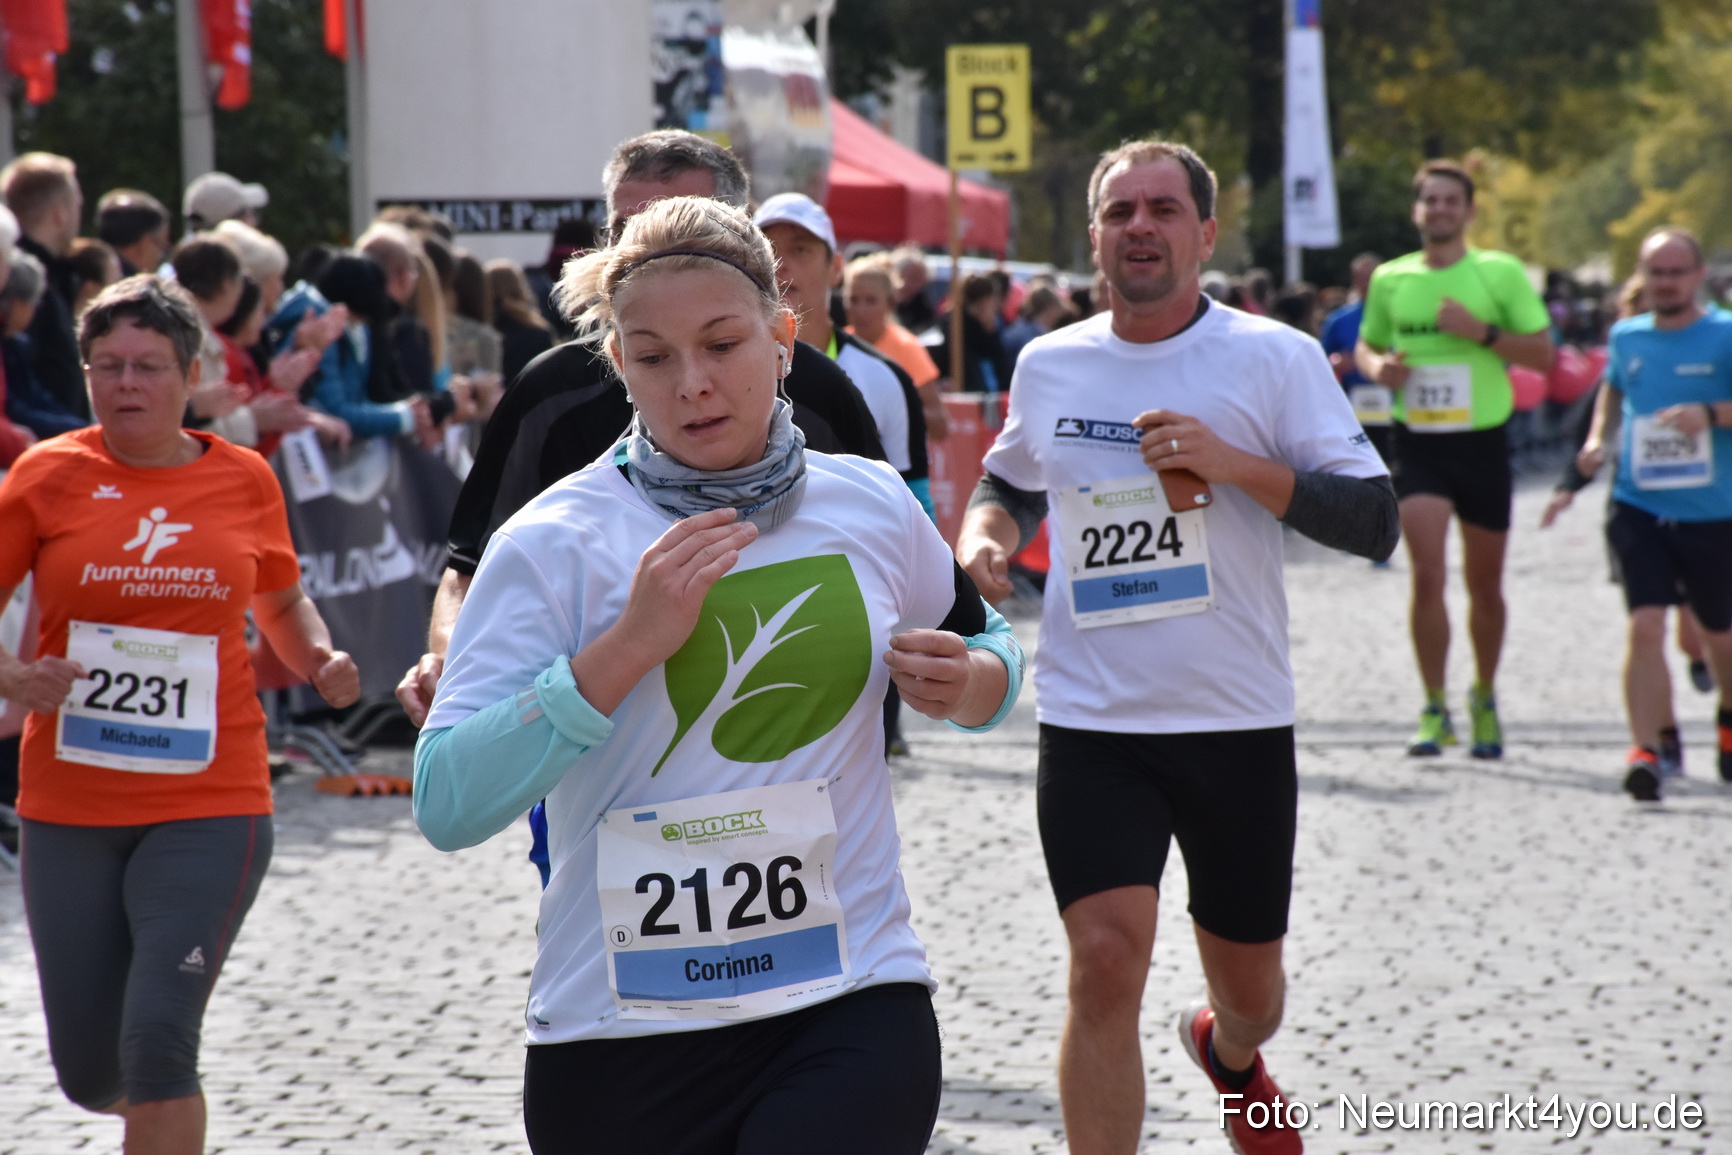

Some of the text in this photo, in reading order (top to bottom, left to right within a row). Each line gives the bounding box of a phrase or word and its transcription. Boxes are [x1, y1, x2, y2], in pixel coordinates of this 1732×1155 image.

[970, 85, 1007, 142] B
[1081, 516, 1183, 569] 2224
[80, 562, 216, 585] funrunners
[121, 581, 232, 601] neumarkt
[1112, 579, 1159, 598] Stefan
[84, 668, 188, 718] 2231
[100, 727, 171, 749] Michaela
[683, 809, 766, 839] BOCK
[686, 829, 769, 846] inspired by smart concepts
[635, 855, 807, 936] 2126
[617, 930, 626, 943] D
[685, 953, 774, 983] Corinna
